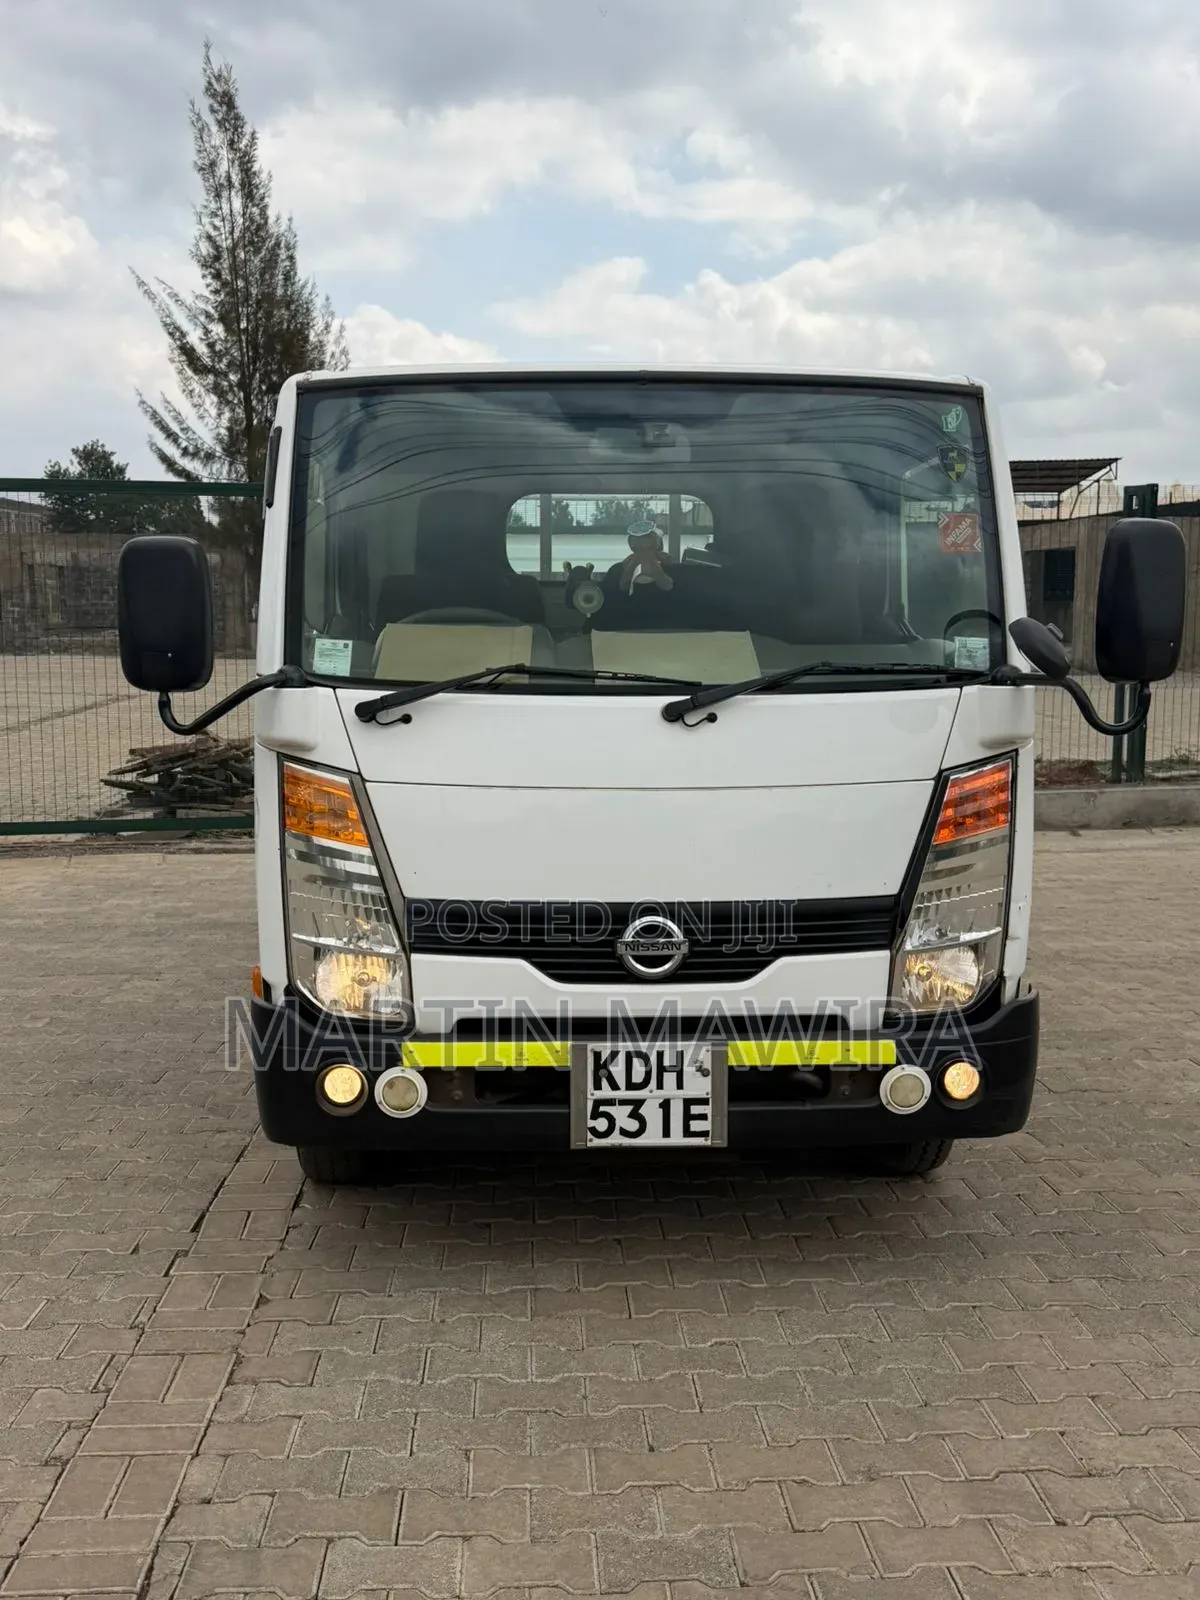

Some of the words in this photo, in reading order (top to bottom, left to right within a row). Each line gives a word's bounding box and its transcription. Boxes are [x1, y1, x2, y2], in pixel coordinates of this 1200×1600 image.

[625, 943, 681, 952] NISSAN
[593, 1050, 684, 1091] KDH
[587, 1098, 710, 1139] 531E
